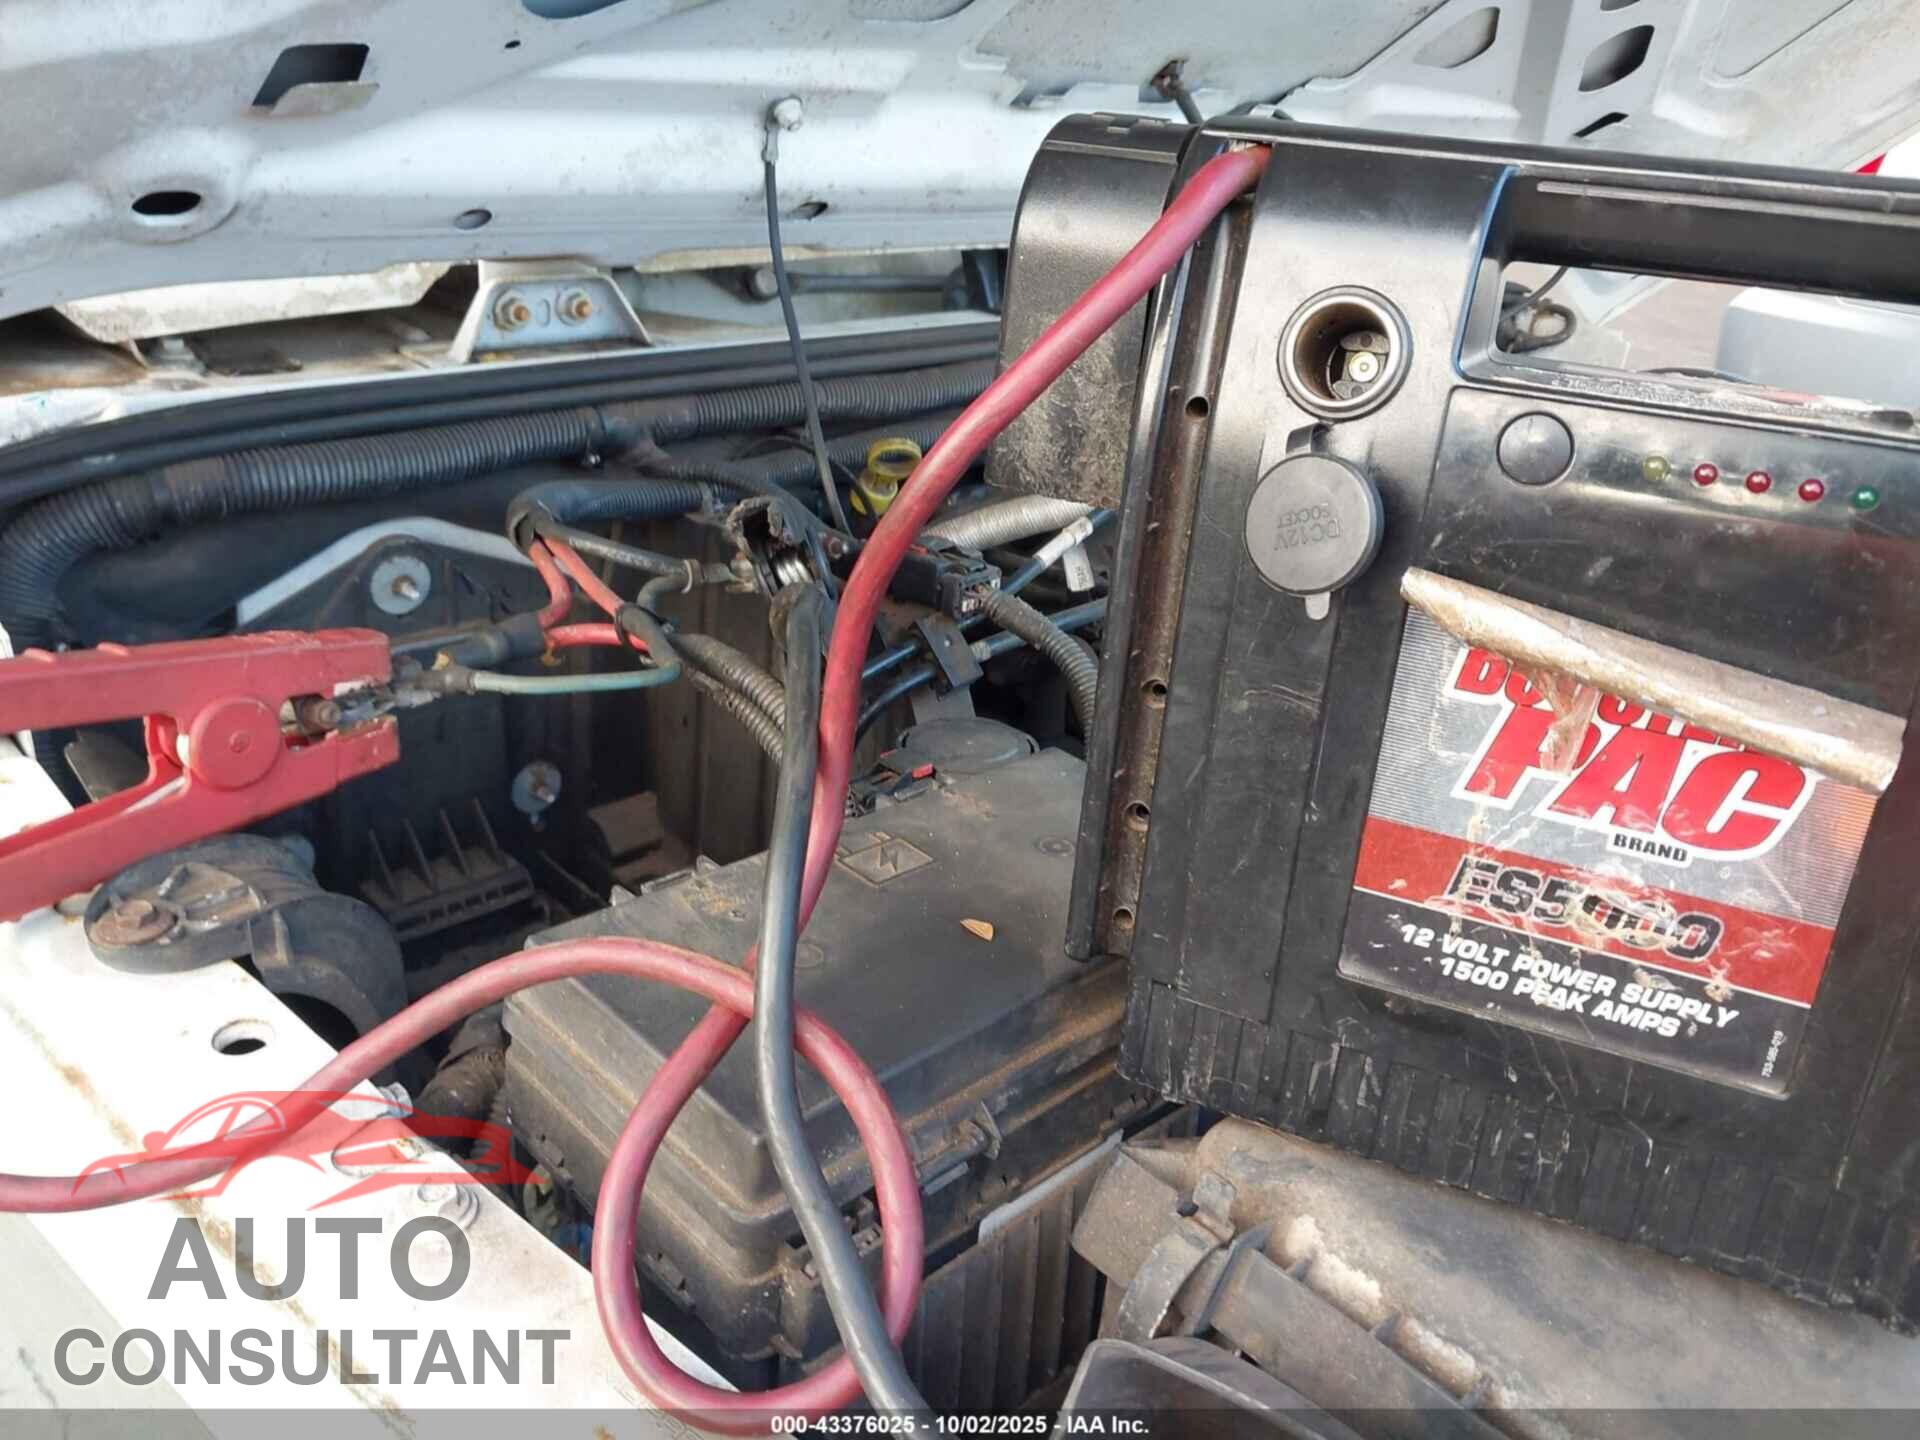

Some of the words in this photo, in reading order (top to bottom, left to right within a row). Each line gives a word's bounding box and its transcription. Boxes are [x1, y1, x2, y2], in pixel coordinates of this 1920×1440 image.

[1461, 702, 1808, 853] PAC
[1612, 833, 1689, 863] BRAND
[1443, 853, 1726, 963] ES5000
[1400, 923, 1435, 949] 12
[1440, 933, 1511, 967] VOLT
[1511, 953, 1617, 997] POWER
[1620, 982, 1740, 1028] SUPPLY
[1439, 956, 1510, 990] 1500
[1512, 976, 1592, 1014] PEAK
[1590, 999, 1681, 1038] AMPS
